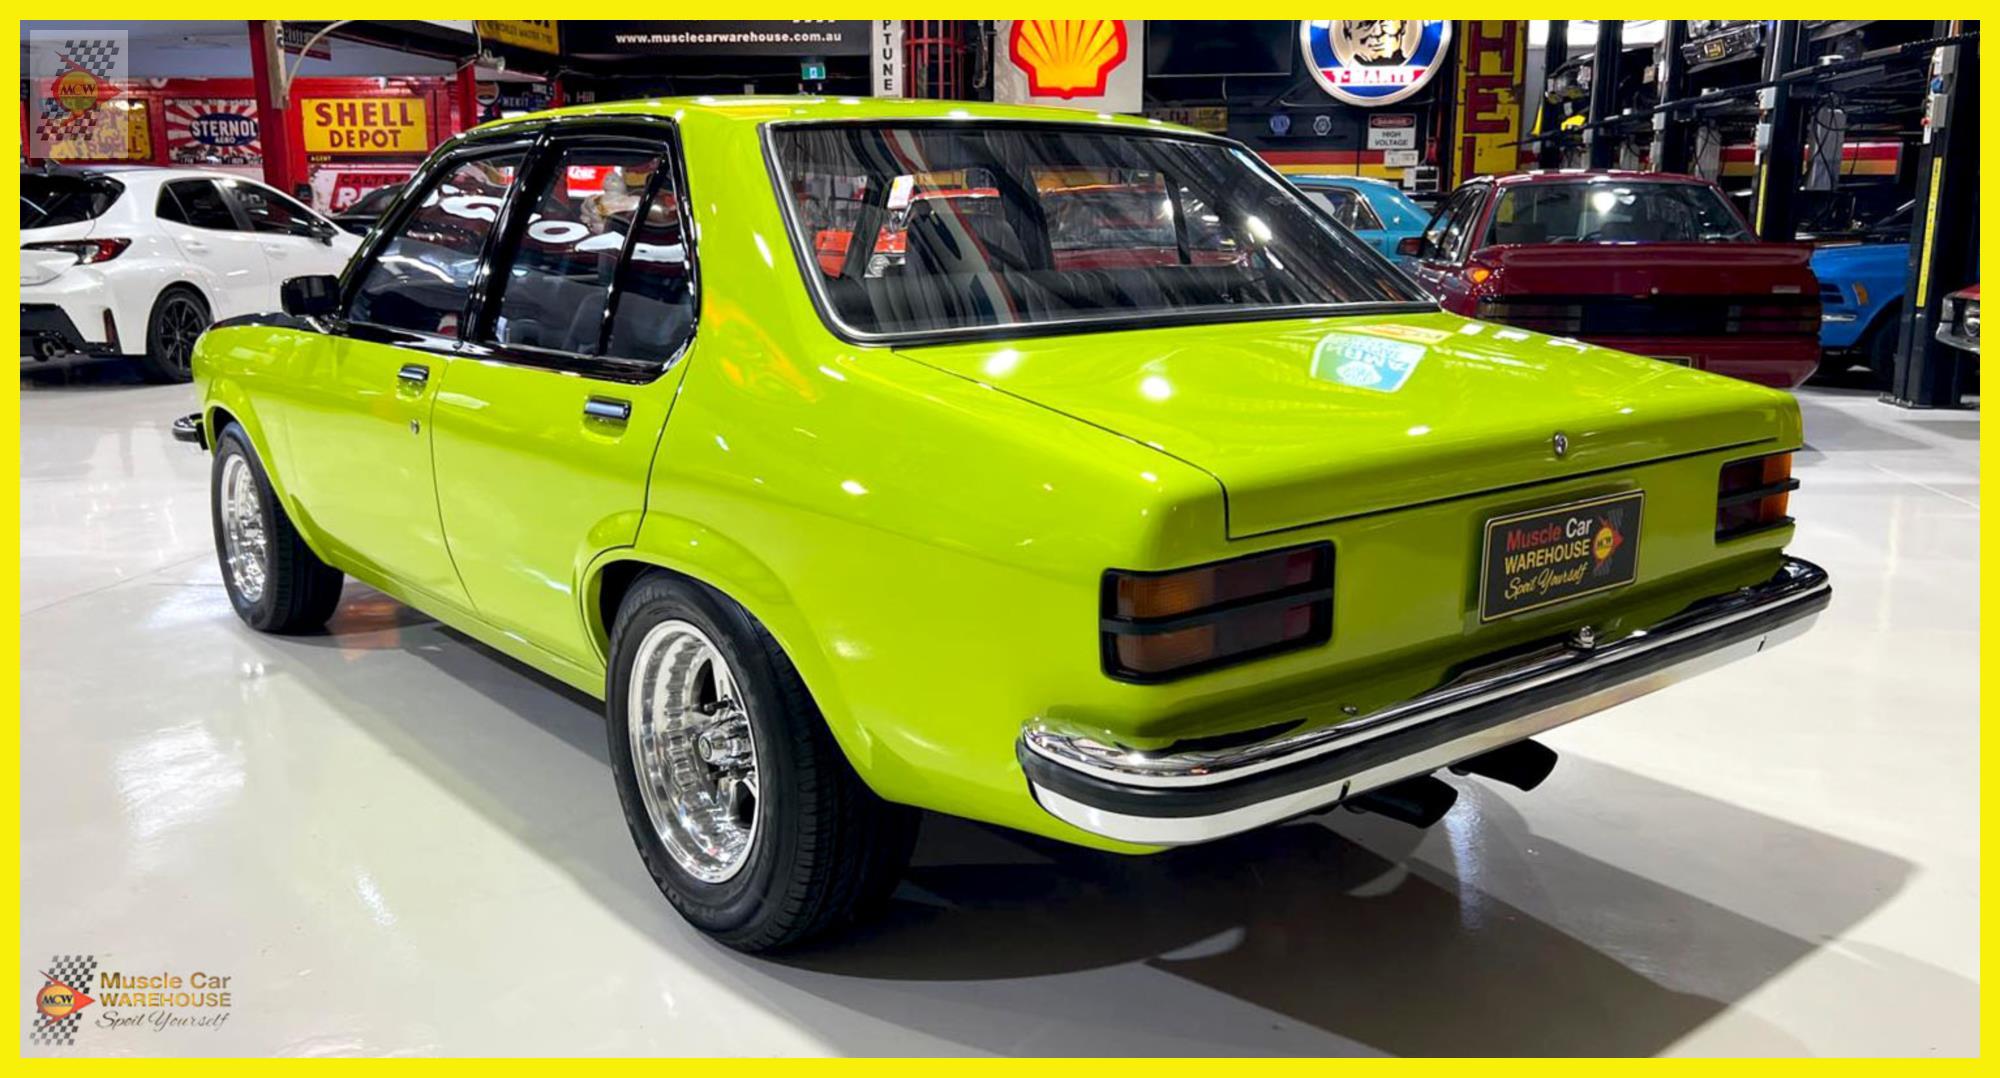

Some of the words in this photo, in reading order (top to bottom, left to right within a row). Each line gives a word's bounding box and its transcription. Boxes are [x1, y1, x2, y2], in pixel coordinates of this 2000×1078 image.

[615, 32, 842, 44] www.musclecarwarehouse.com.au
[315, 102, 415, 127] SHELL
[191, 120, 257, 137] STERNOL
[329, 129, 402, 148] DEPOT
[1506, 523, 1562, 551] Muscle
[1566, 517, 1593, 538] Car
[1504, 539, 1591, 575] WAREHOUSE
